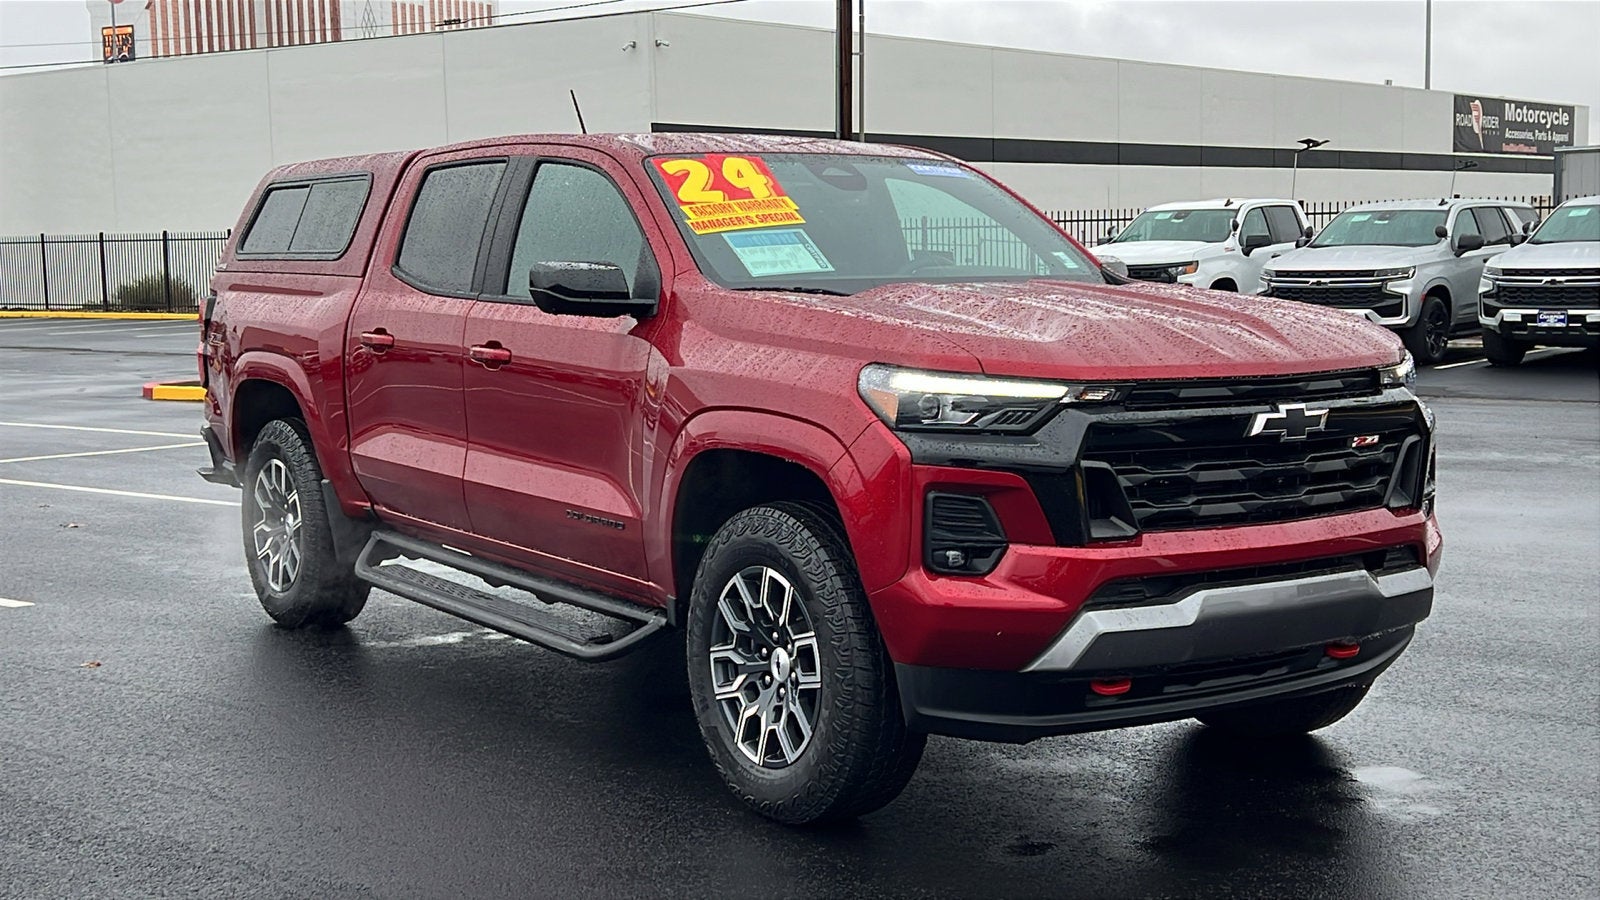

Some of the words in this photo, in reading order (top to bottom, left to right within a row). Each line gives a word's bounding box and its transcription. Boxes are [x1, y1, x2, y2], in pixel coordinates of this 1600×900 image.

[1456, 113, 1473, 127] ROAD
[1482, 115, 1500, 129] RIDER
[1504, 103, 1570, 129] Motorcycle
[1535, 129, 1548, 141] Parts
[661, 156, 771, 203] 24
[688, 202, 736, 218] FACTORY
[735, 197, 791, 212] WARRANTY
[690, 215, 756, 232] MANAGER'S
[755, 211, 800, 224] SPECIAL
